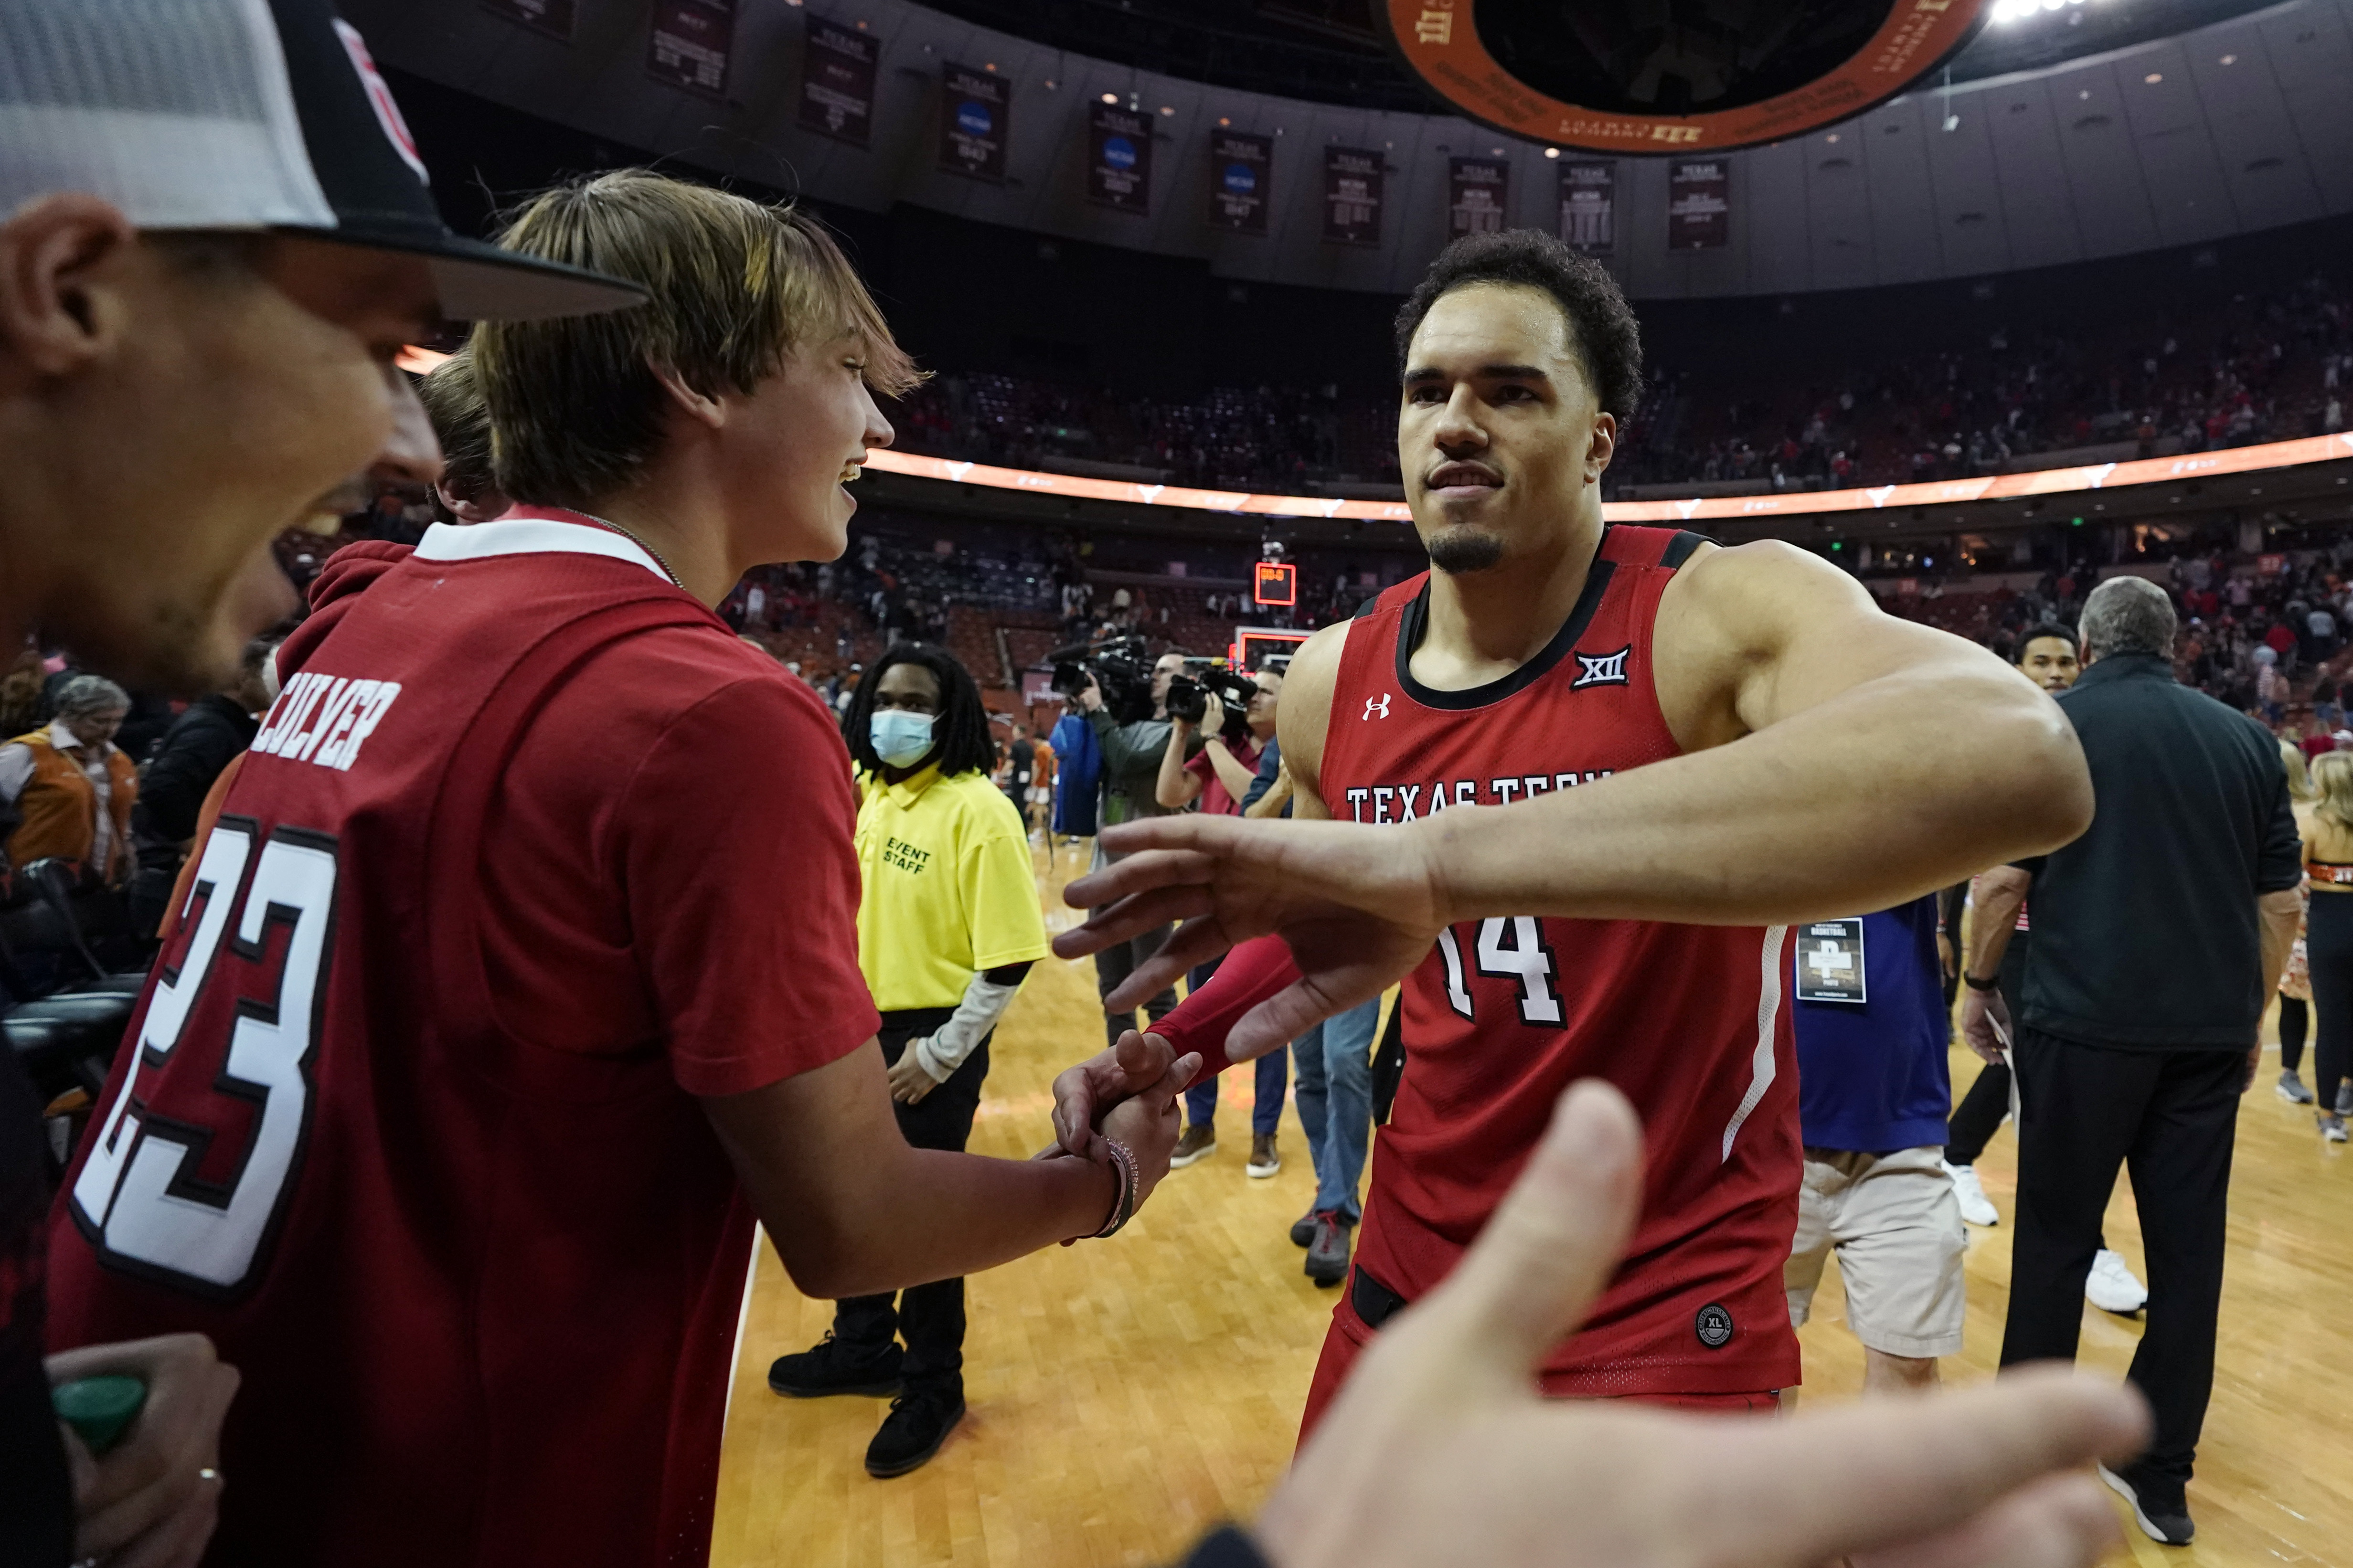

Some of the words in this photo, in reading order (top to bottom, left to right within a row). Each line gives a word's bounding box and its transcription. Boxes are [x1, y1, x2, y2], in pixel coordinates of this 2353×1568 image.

[250, 672, 402, 772] CULVER
[1347, 781, 1476, 825] TEXAS
[884, 850, 925, 874] STAFF
[887, 837, 930, 863] EVENT
[1437, 916, 1564, 1026] 14
[71, 819, 337, 1295] 23
[1708, 1318, 1722, 1327] XL
